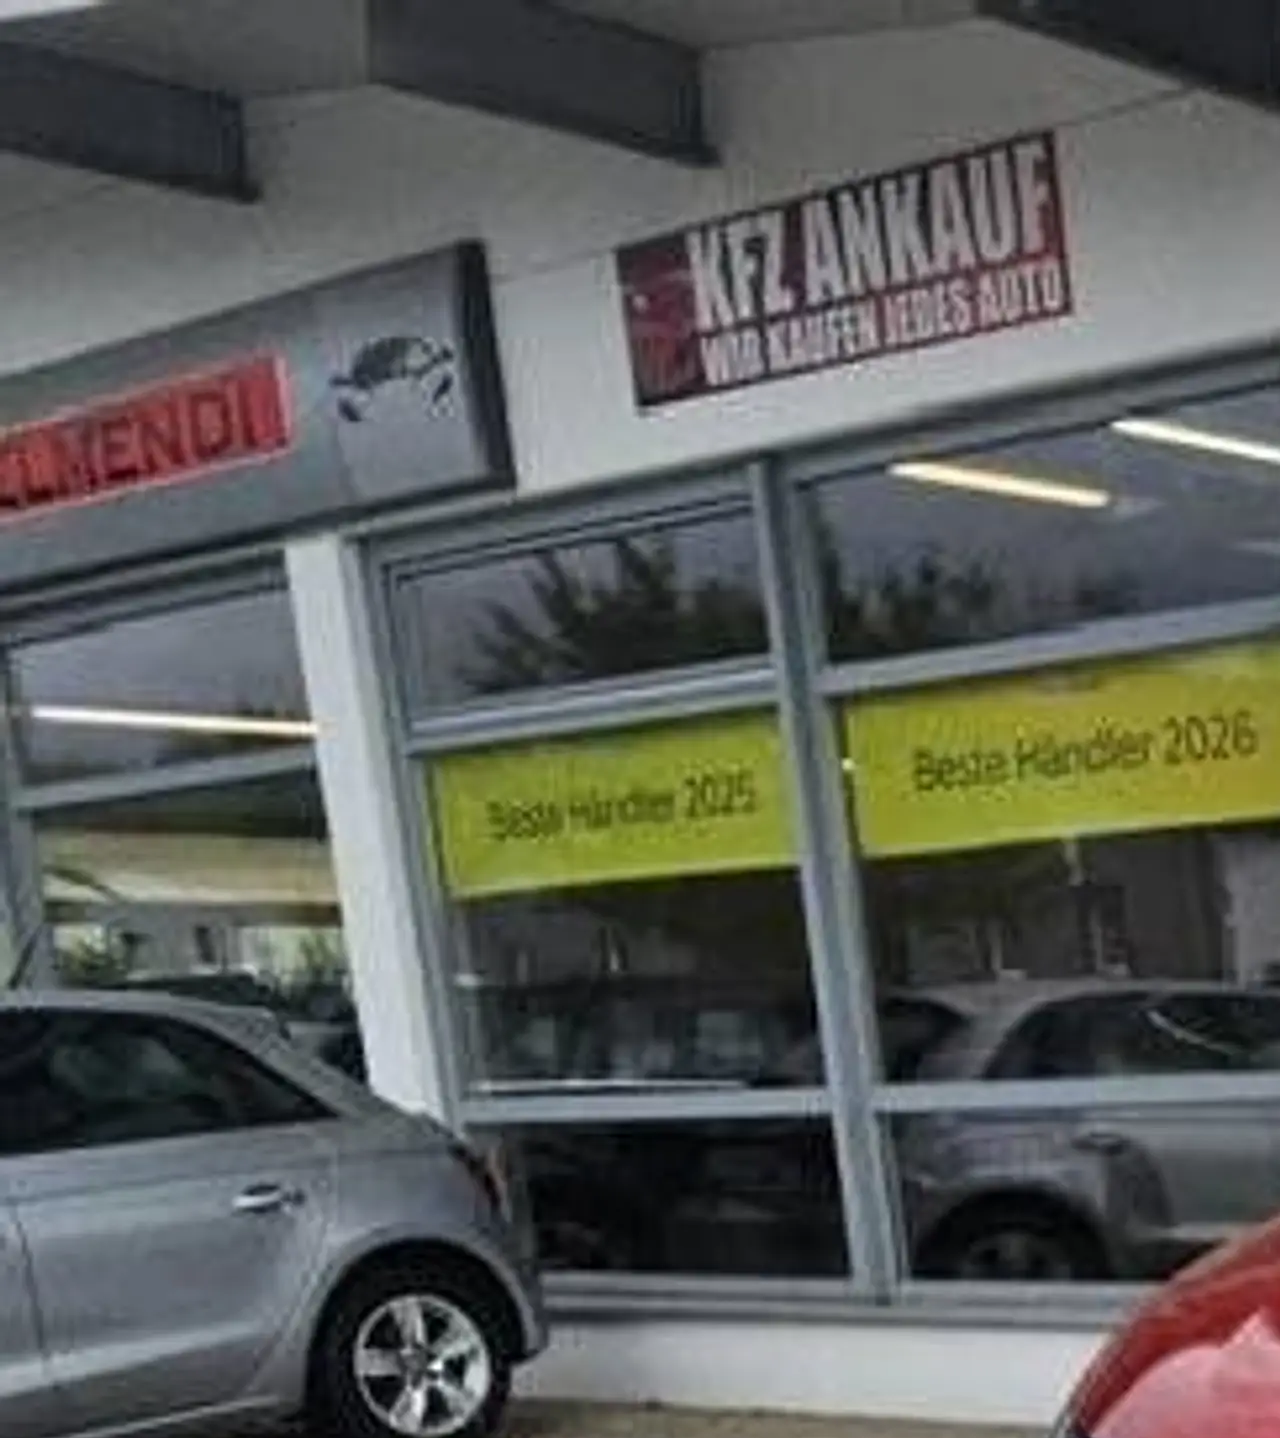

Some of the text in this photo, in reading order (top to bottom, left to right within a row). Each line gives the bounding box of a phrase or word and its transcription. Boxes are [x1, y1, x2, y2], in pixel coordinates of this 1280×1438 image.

[685, 139, 1049, 329] KFZ ANKAUF
[701, 260, 1062, 387] WIR KAUFEN JEDES AUTO
[911, 710, 1259, 792] Beste Händler 2026
[485, 768, 758, 841] Beste Händler 2025
